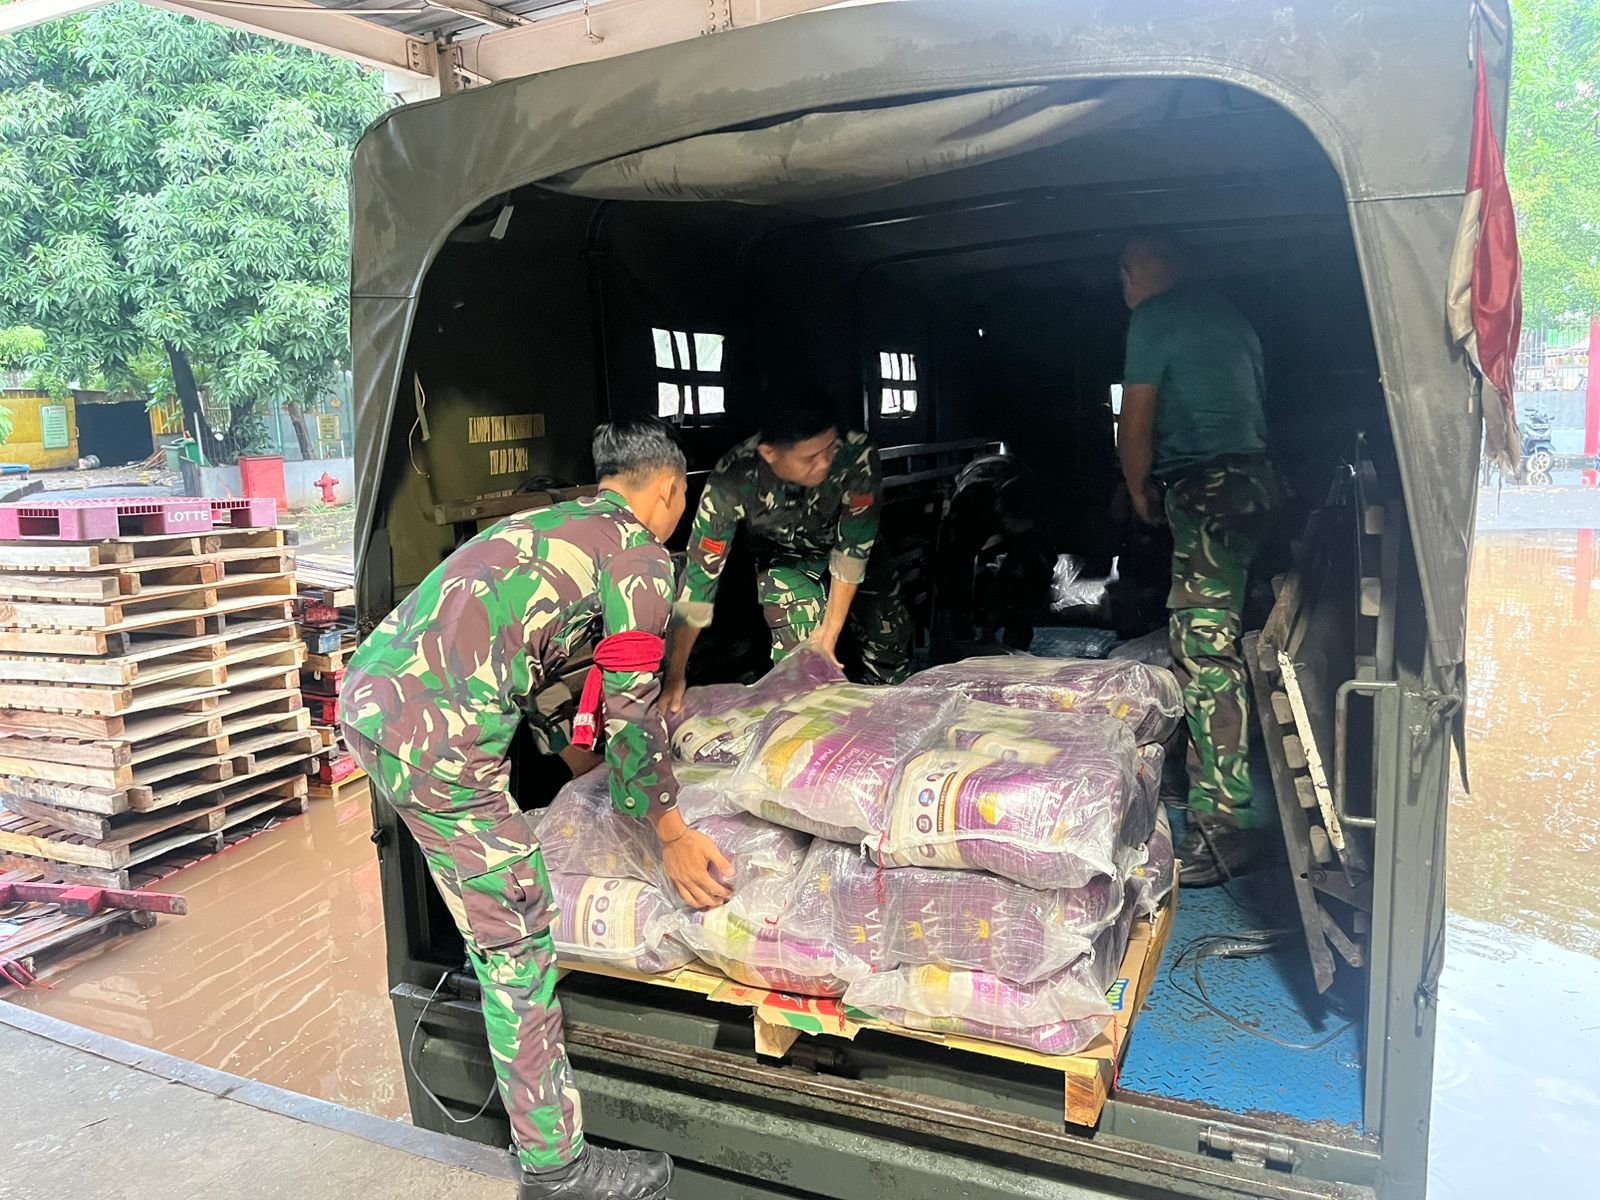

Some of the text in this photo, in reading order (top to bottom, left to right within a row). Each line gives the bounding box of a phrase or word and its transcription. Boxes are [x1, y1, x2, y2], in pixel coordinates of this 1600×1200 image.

[167, 510, 209, 523] LOTTE
[864, 907, 885, 961] RAJA
[991, 899, 1011, 960] RAJA
